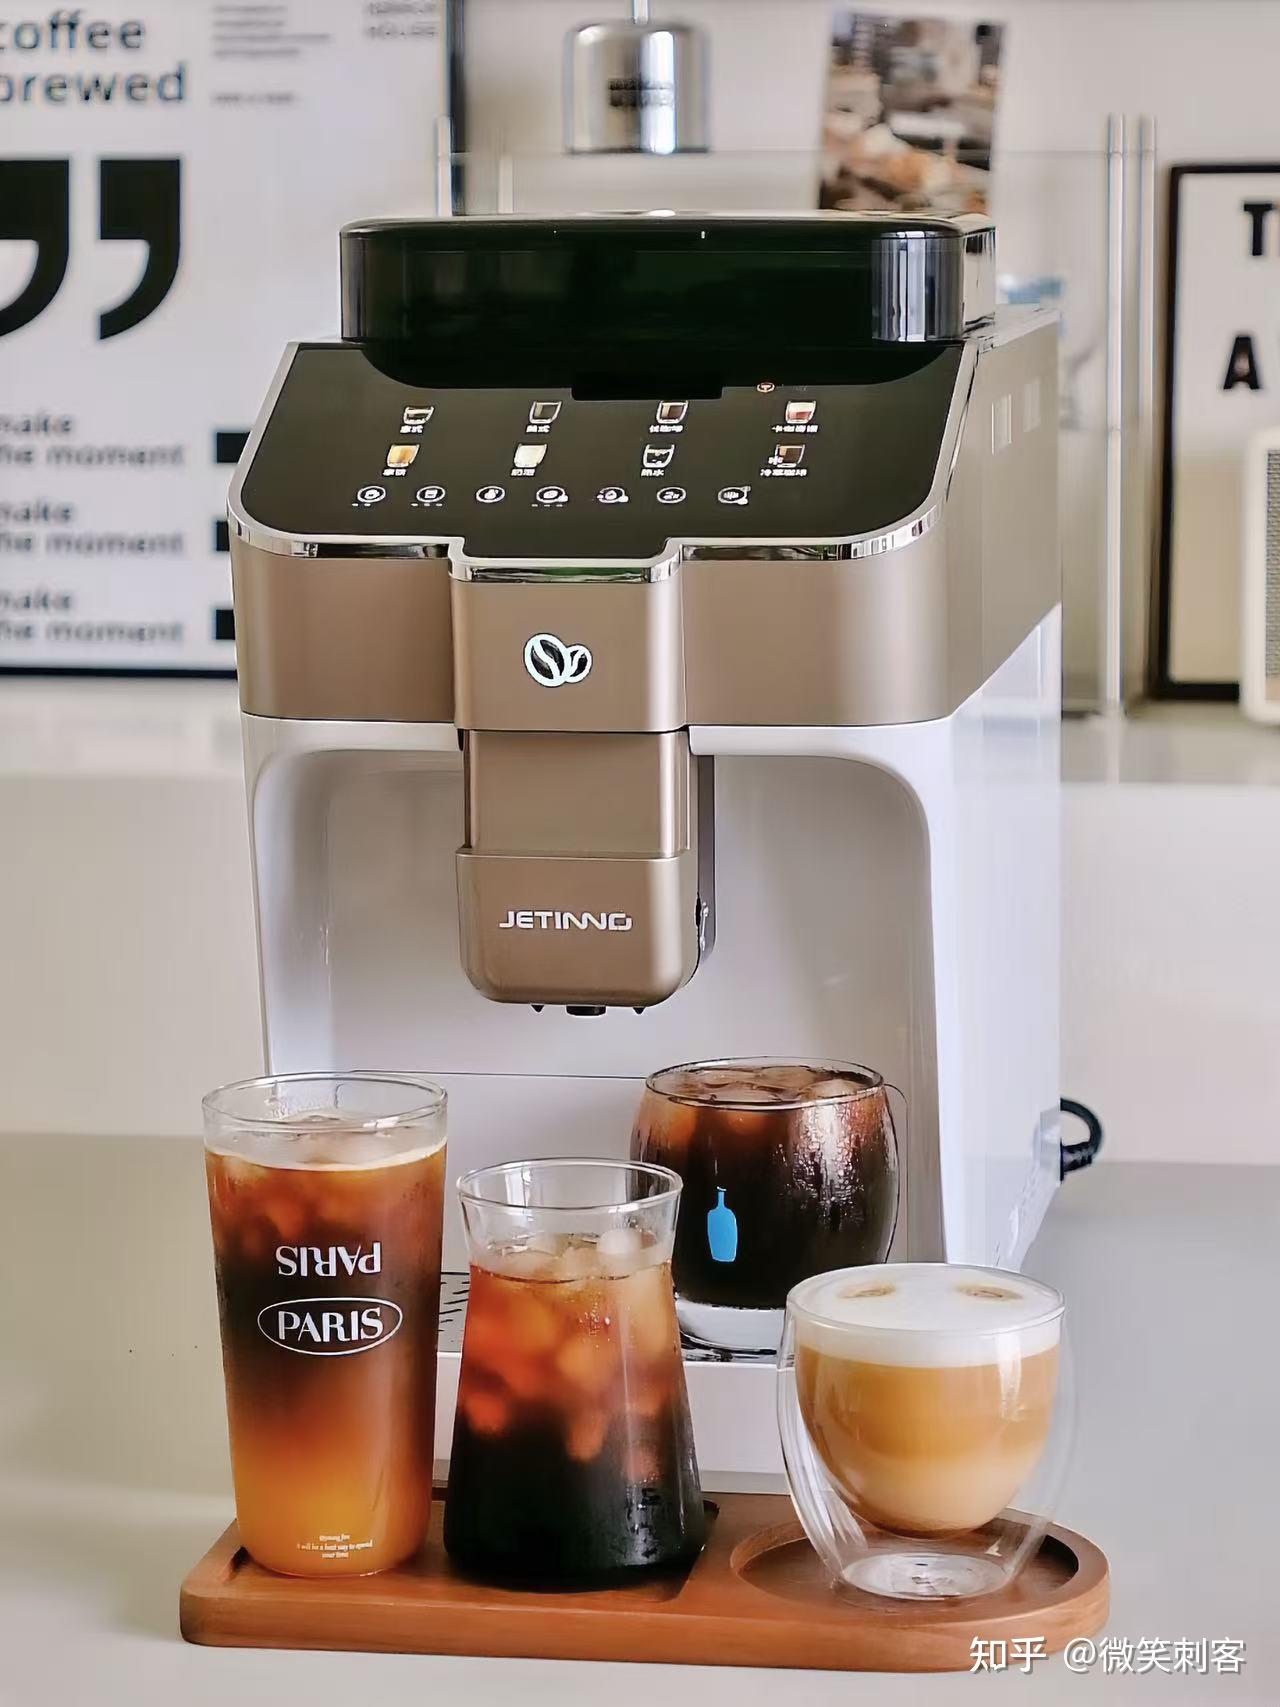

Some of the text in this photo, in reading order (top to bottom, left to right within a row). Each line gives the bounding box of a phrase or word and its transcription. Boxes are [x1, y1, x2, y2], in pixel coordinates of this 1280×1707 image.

[499, 911, 633, 931] JETINNO
[275, 1242, 382, 1277] PARIS
[278, 1306, 384, 1342] PARIS
